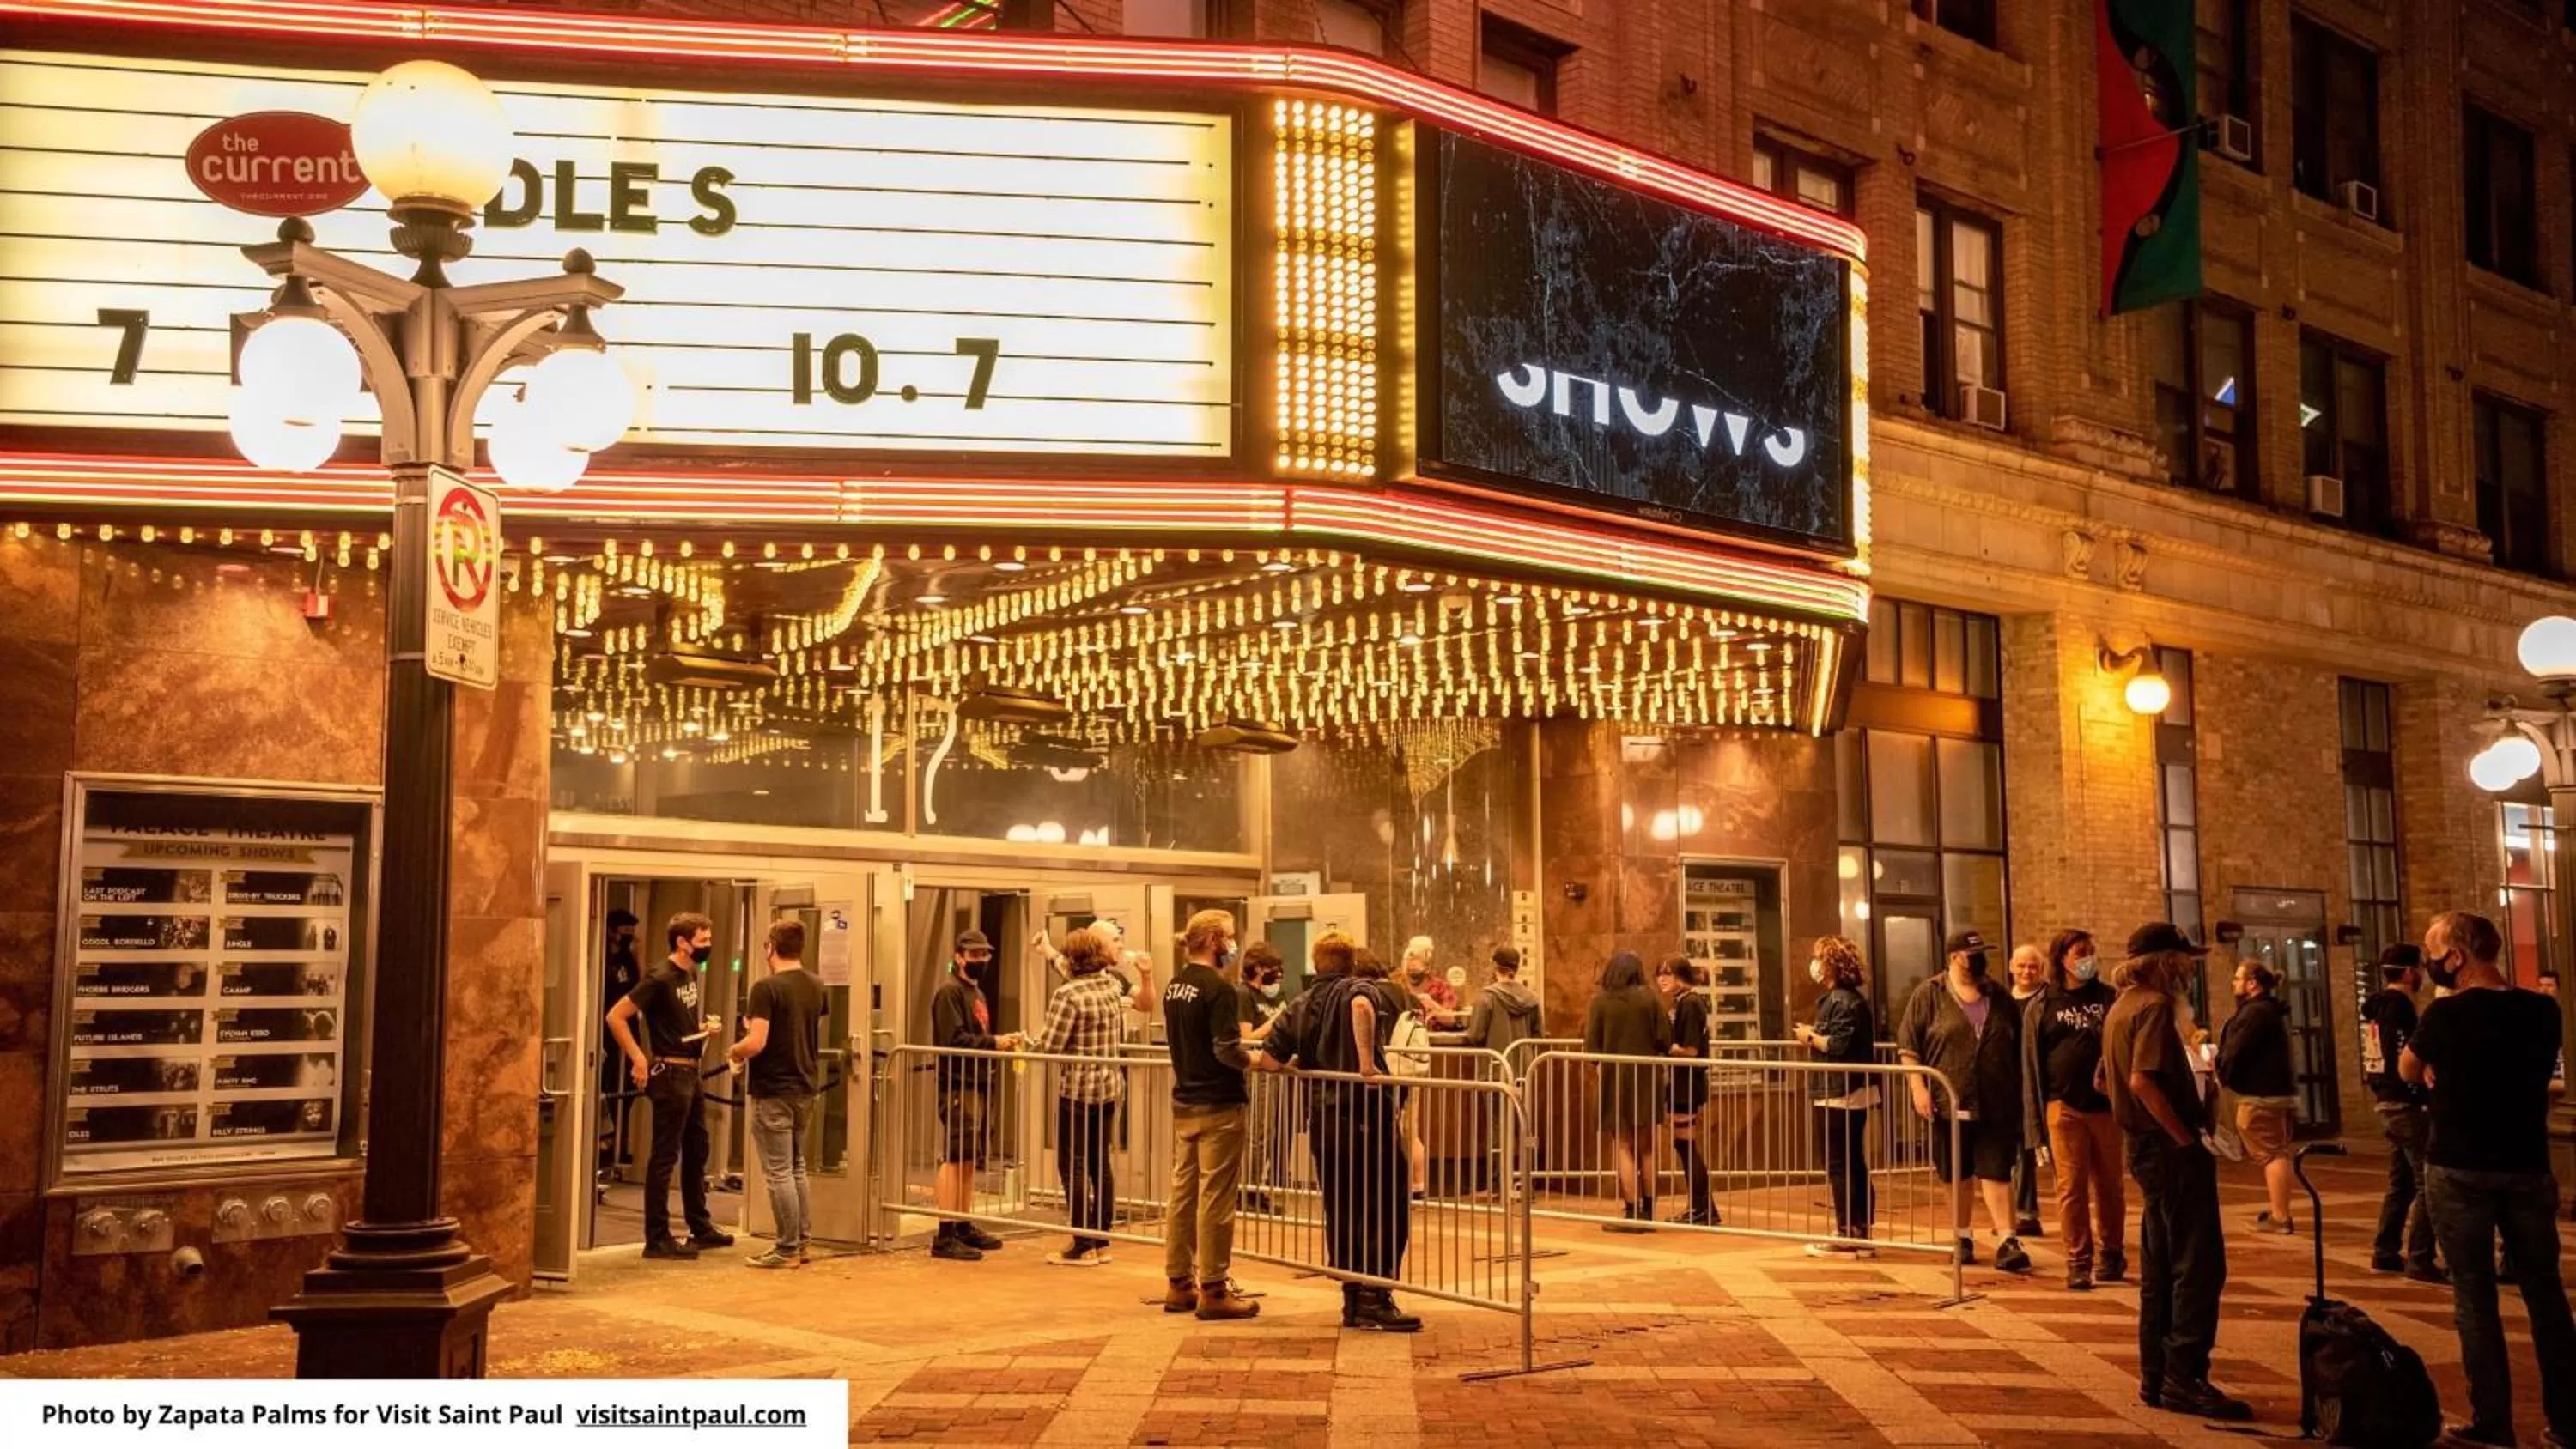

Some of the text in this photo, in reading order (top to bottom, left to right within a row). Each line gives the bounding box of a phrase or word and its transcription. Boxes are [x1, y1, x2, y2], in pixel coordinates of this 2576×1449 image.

[222, 132, 259, 152] the
[202, 150, 361, 184] current
[484, 156, 738, 237] DLES
[143, 842, 296, 860] UPCOMING SHOWS
[1686, 882, 1704, 892] ACE
[1166, 983, 1200, 1003] STAFF
